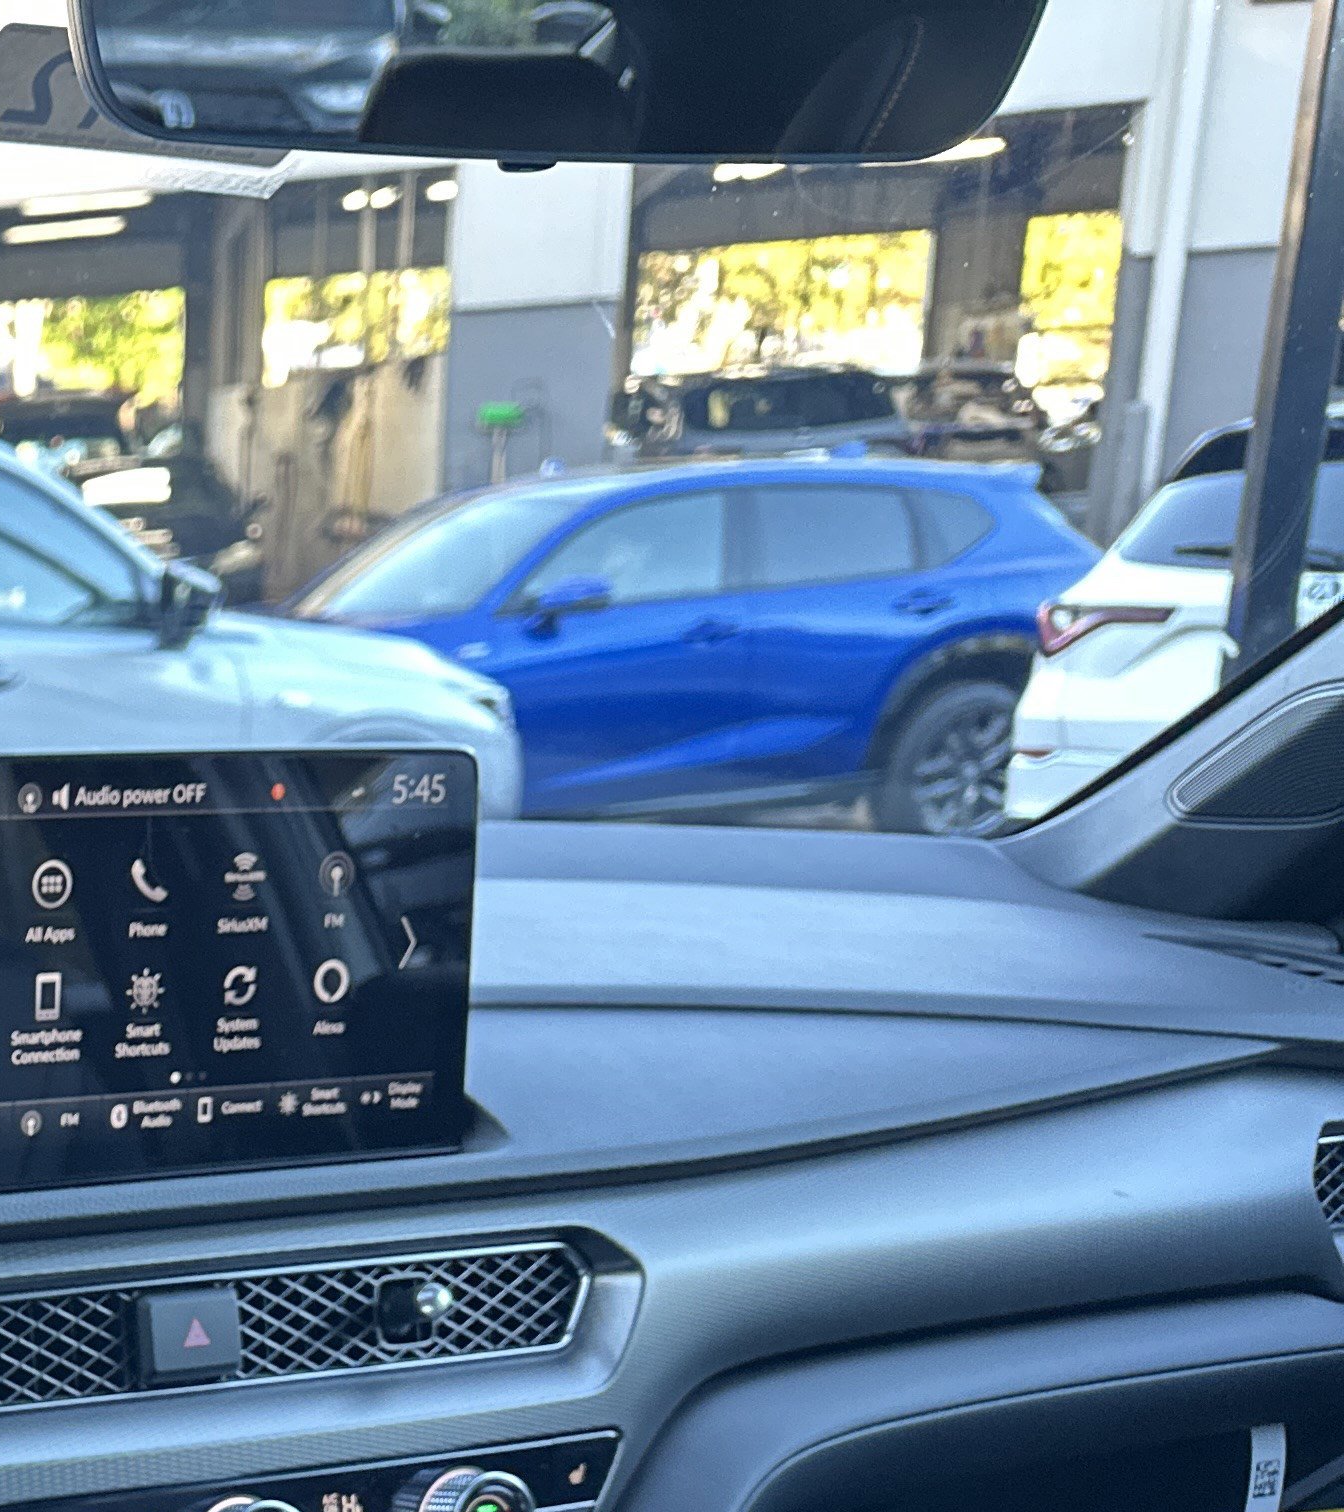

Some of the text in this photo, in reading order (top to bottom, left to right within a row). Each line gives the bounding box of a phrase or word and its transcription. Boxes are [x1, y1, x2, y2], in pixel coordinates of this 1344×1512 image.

[74, 783, 207, 808] Audio power OFF
[392, 774, 446, 805] 5:45
[25, 926, 76, 944] All Apps
[128, 921, 168, 938] Phone
[11, 1029, 83, 1046] Smartphone
[11, 1048, 81, 1066] Connection
